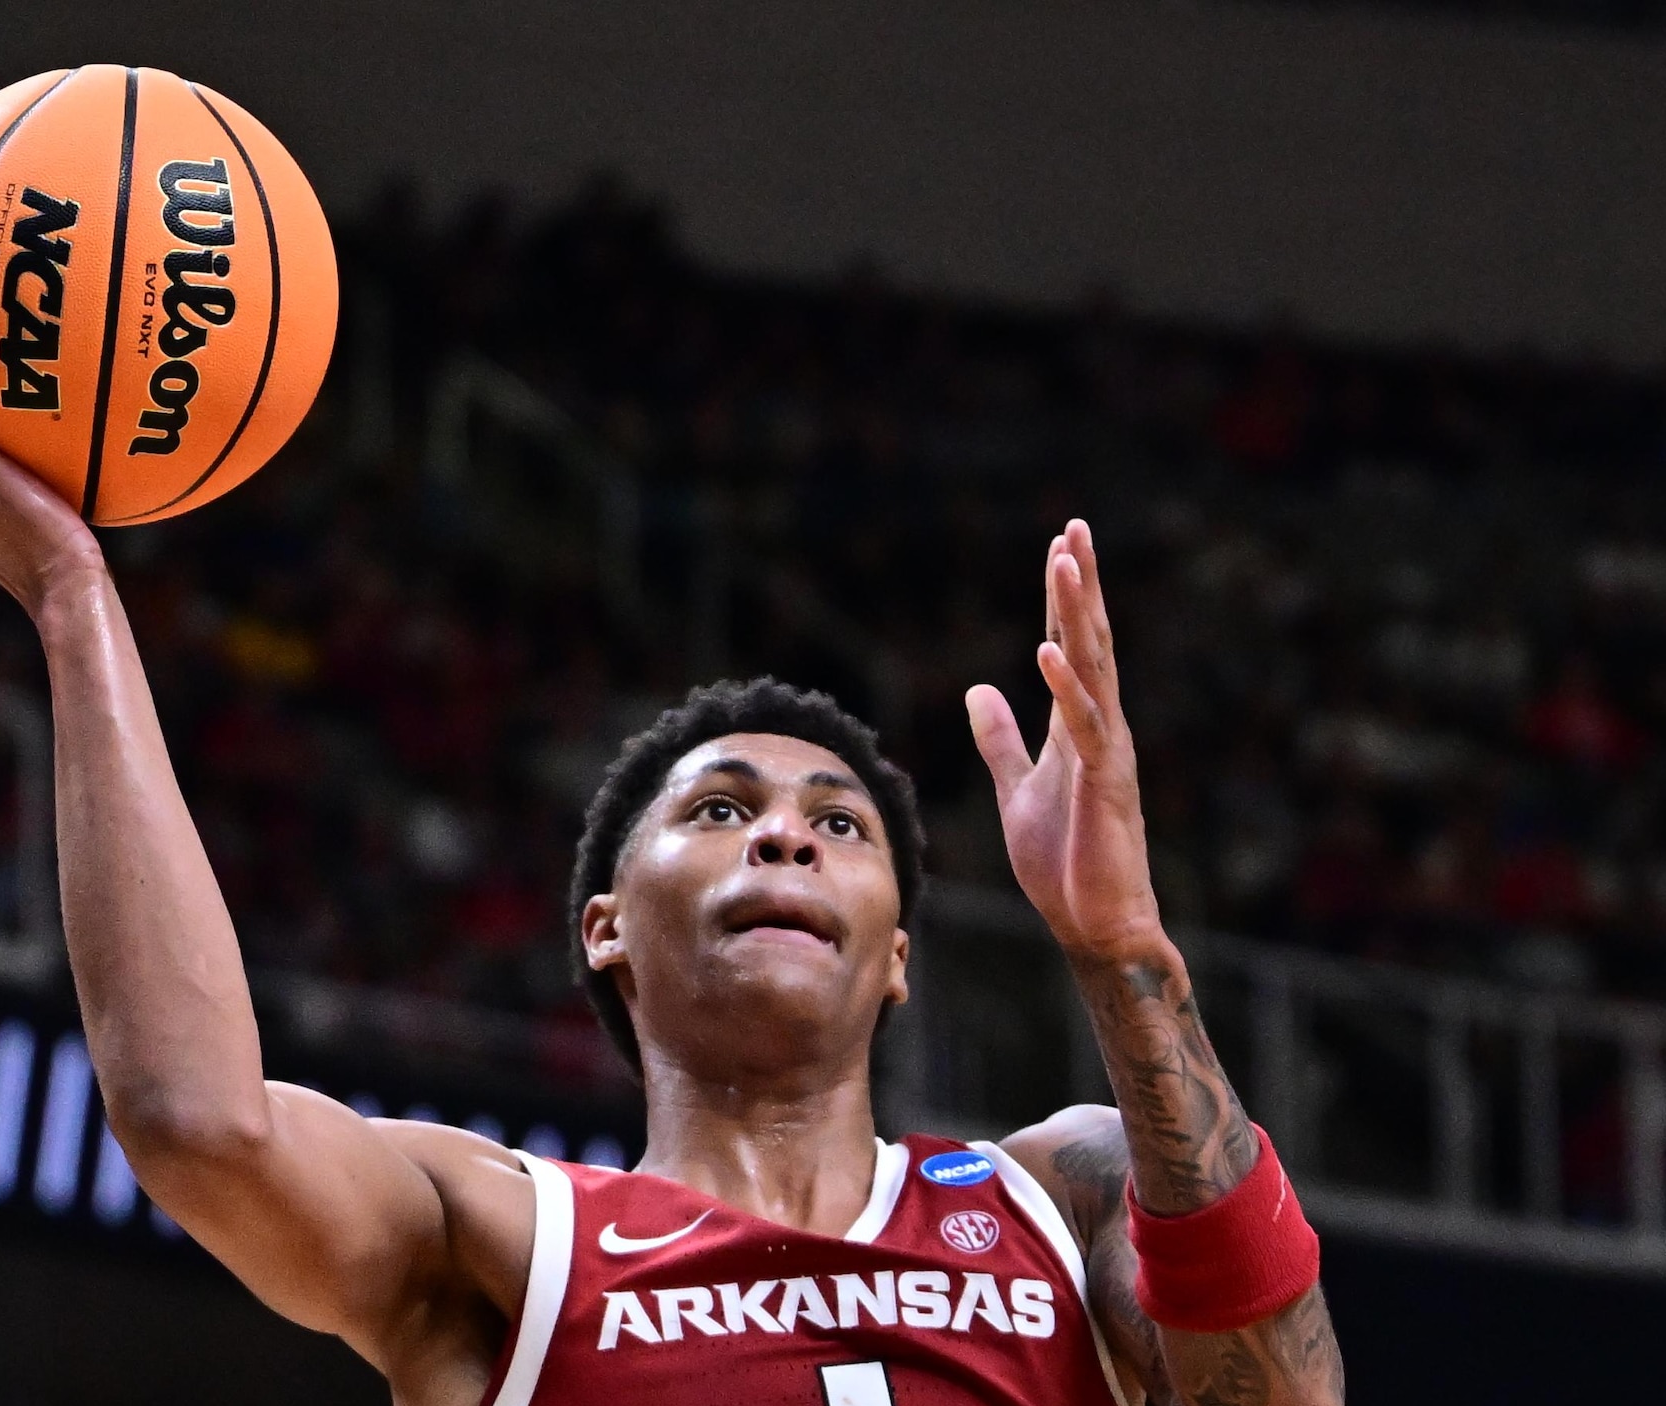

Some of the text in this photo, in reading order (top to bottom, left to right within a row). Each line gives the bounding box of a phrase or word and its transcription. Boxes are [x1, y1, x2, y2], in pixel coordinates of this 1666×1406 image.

[126, 156, 236, 457] Wilson
[137, 262, 157, 359] EVO NXT
[934, 1159, 991, 1180] NCAA
[944, 1212, 994, 1250] SEC
[596, 1269, 1056, 1351] ARKANSAS
